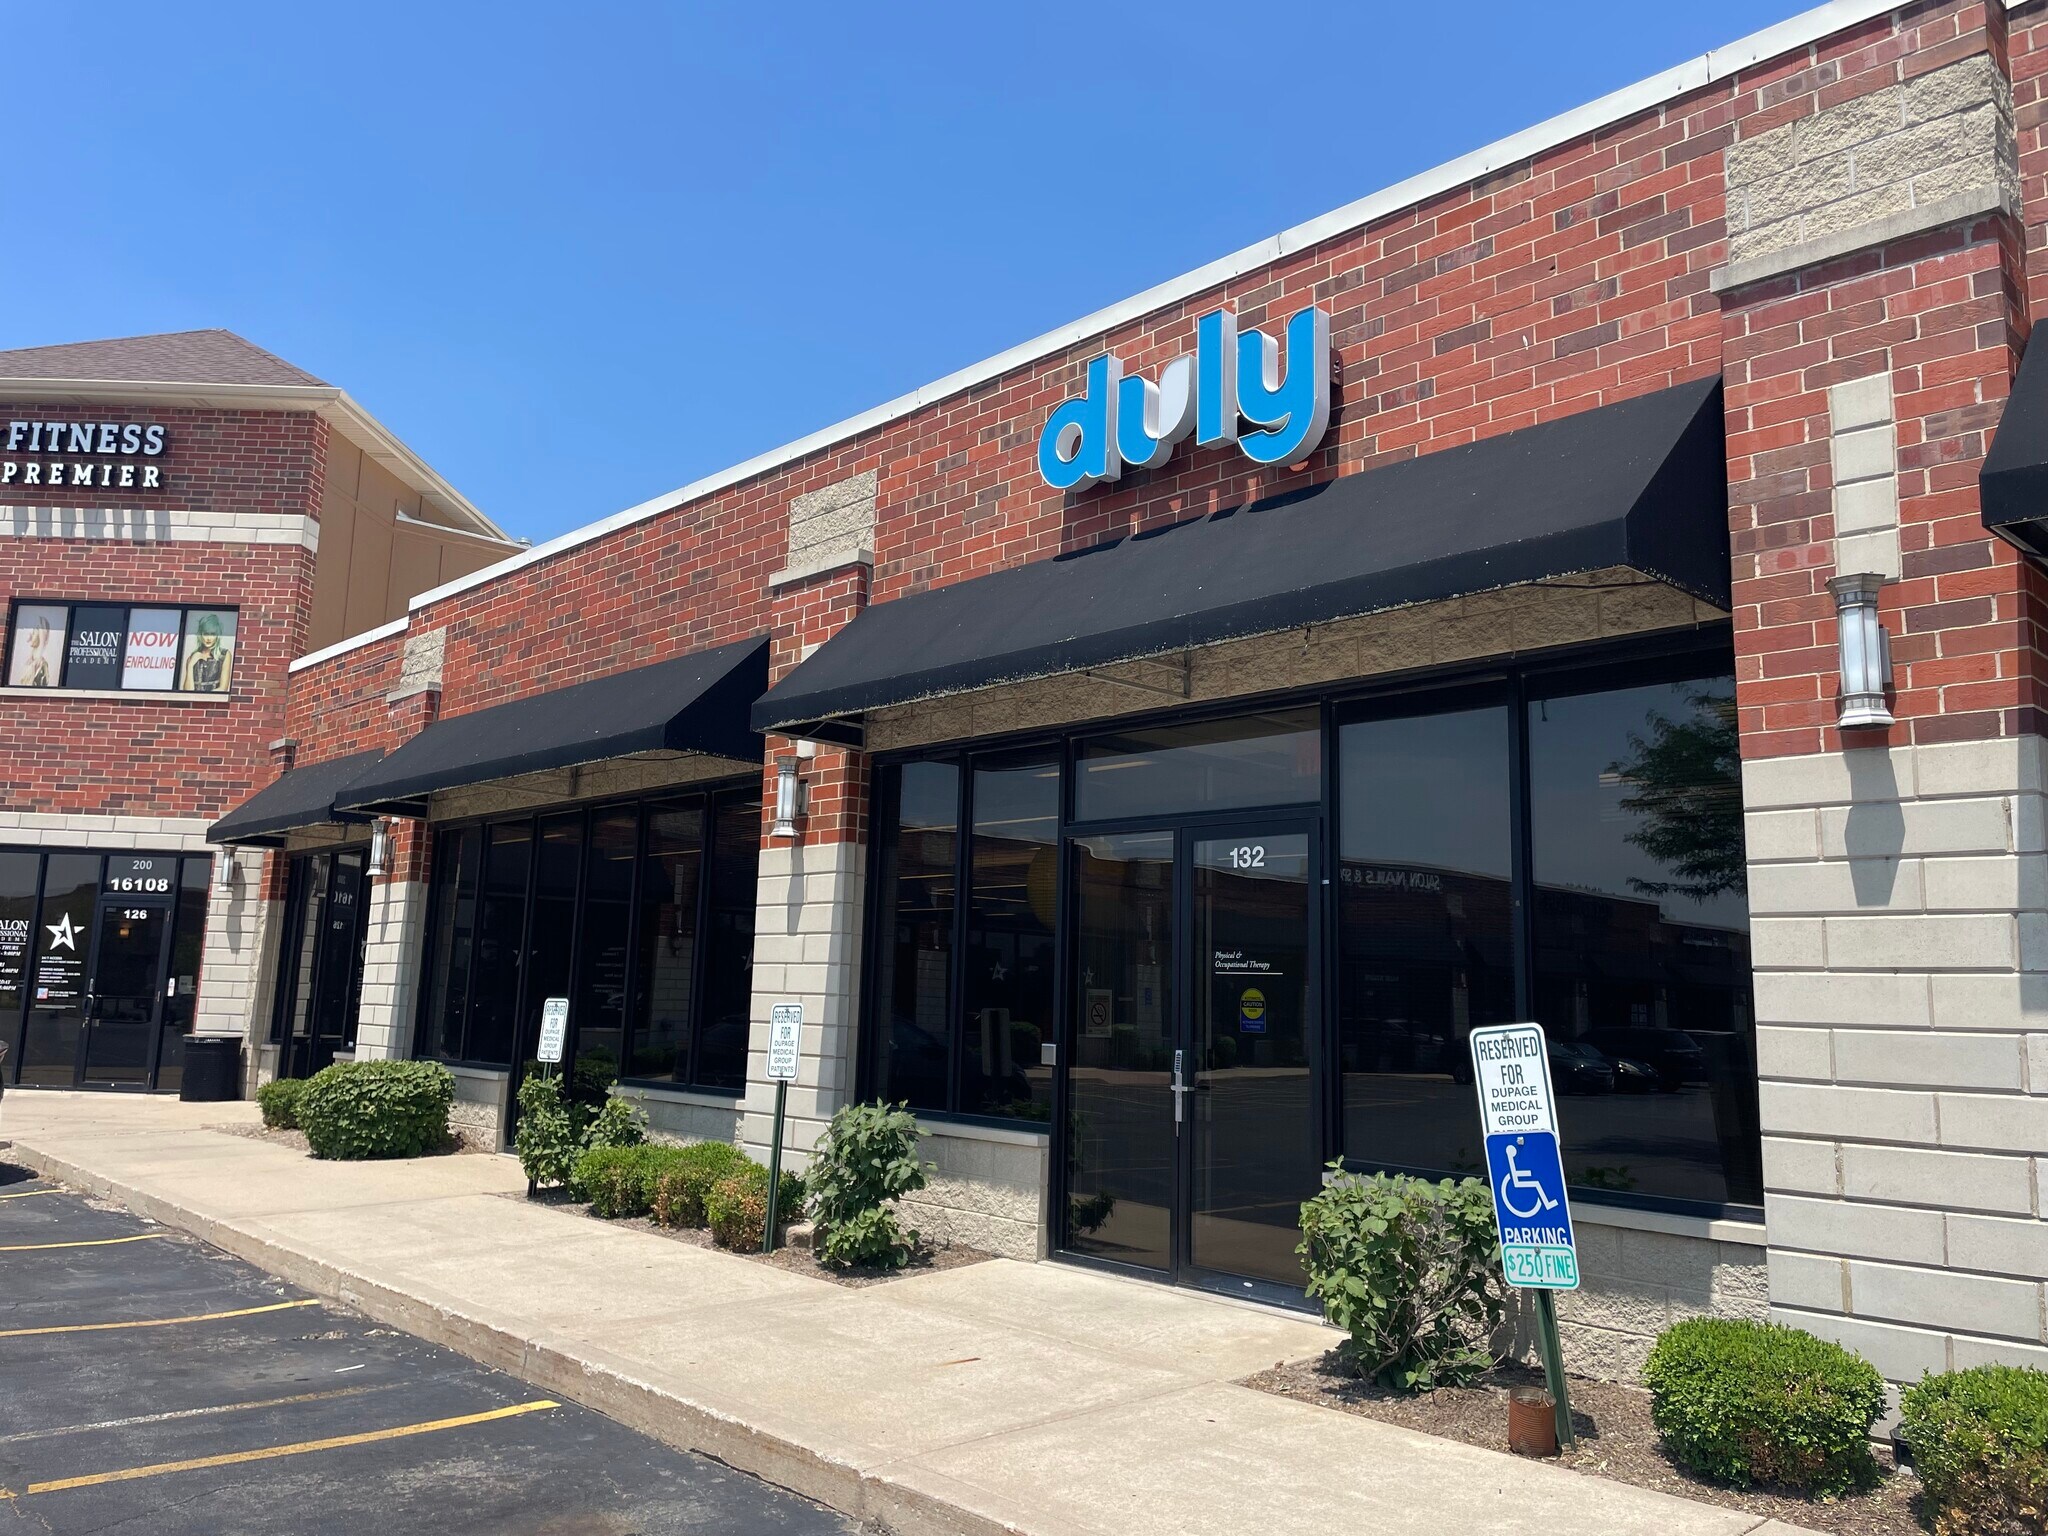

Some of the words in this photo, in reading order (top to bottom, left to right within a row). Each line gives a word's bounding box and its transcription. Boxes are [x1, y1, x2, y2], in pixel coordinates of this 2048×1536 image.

[1037, 304, 1329, 491] duly
[7, 421, 165, 455] FITNESS
[1, 462, 160, 487] PREMIER
[80, 631, 119, 647] SALON
[129, 632, 178, 647] NOW
[70, 647, 117, 657] PROFESSIONAL
[69, 657, 117, 665] ACADEMY
[125, 656, 176, 669] ENROLLING
[1229, 845, 1265, 869] 132
[132, 860, 153, 870] 200
[110, 877, 169, 892] 16108
[124, 909, 147, 919] 126
[1215, 951, 1236, 960] Physical
[1236, 951, 1243, 959] &
[1215, 960, 1249, 970] Occupational
[1249, 960, 1271, 970] Therapy
[774, 1010, 800, 1024] RESERVED
[780, 1026, 791, 1039] FOR
[773, 1048, 795, 1056] MEDICAL
[1479, 1036, 1539, 1061] RESERVED
[771, 1065, 794, 1073] PATIENTS
[1500, 1063, 1524, 1086] FOR
[1491, 1086, 1538, 1099] DUPAGE
[1491, 1099, 1543, 1112] MEDICAL
[1498, 1114, 1539, 1126] GROUP
[1504, 1227, 1568, 1245] PARKING
[1508, 1251, 1543, 1278] $250
[1546, 1254, 1574, 1279] FINE
